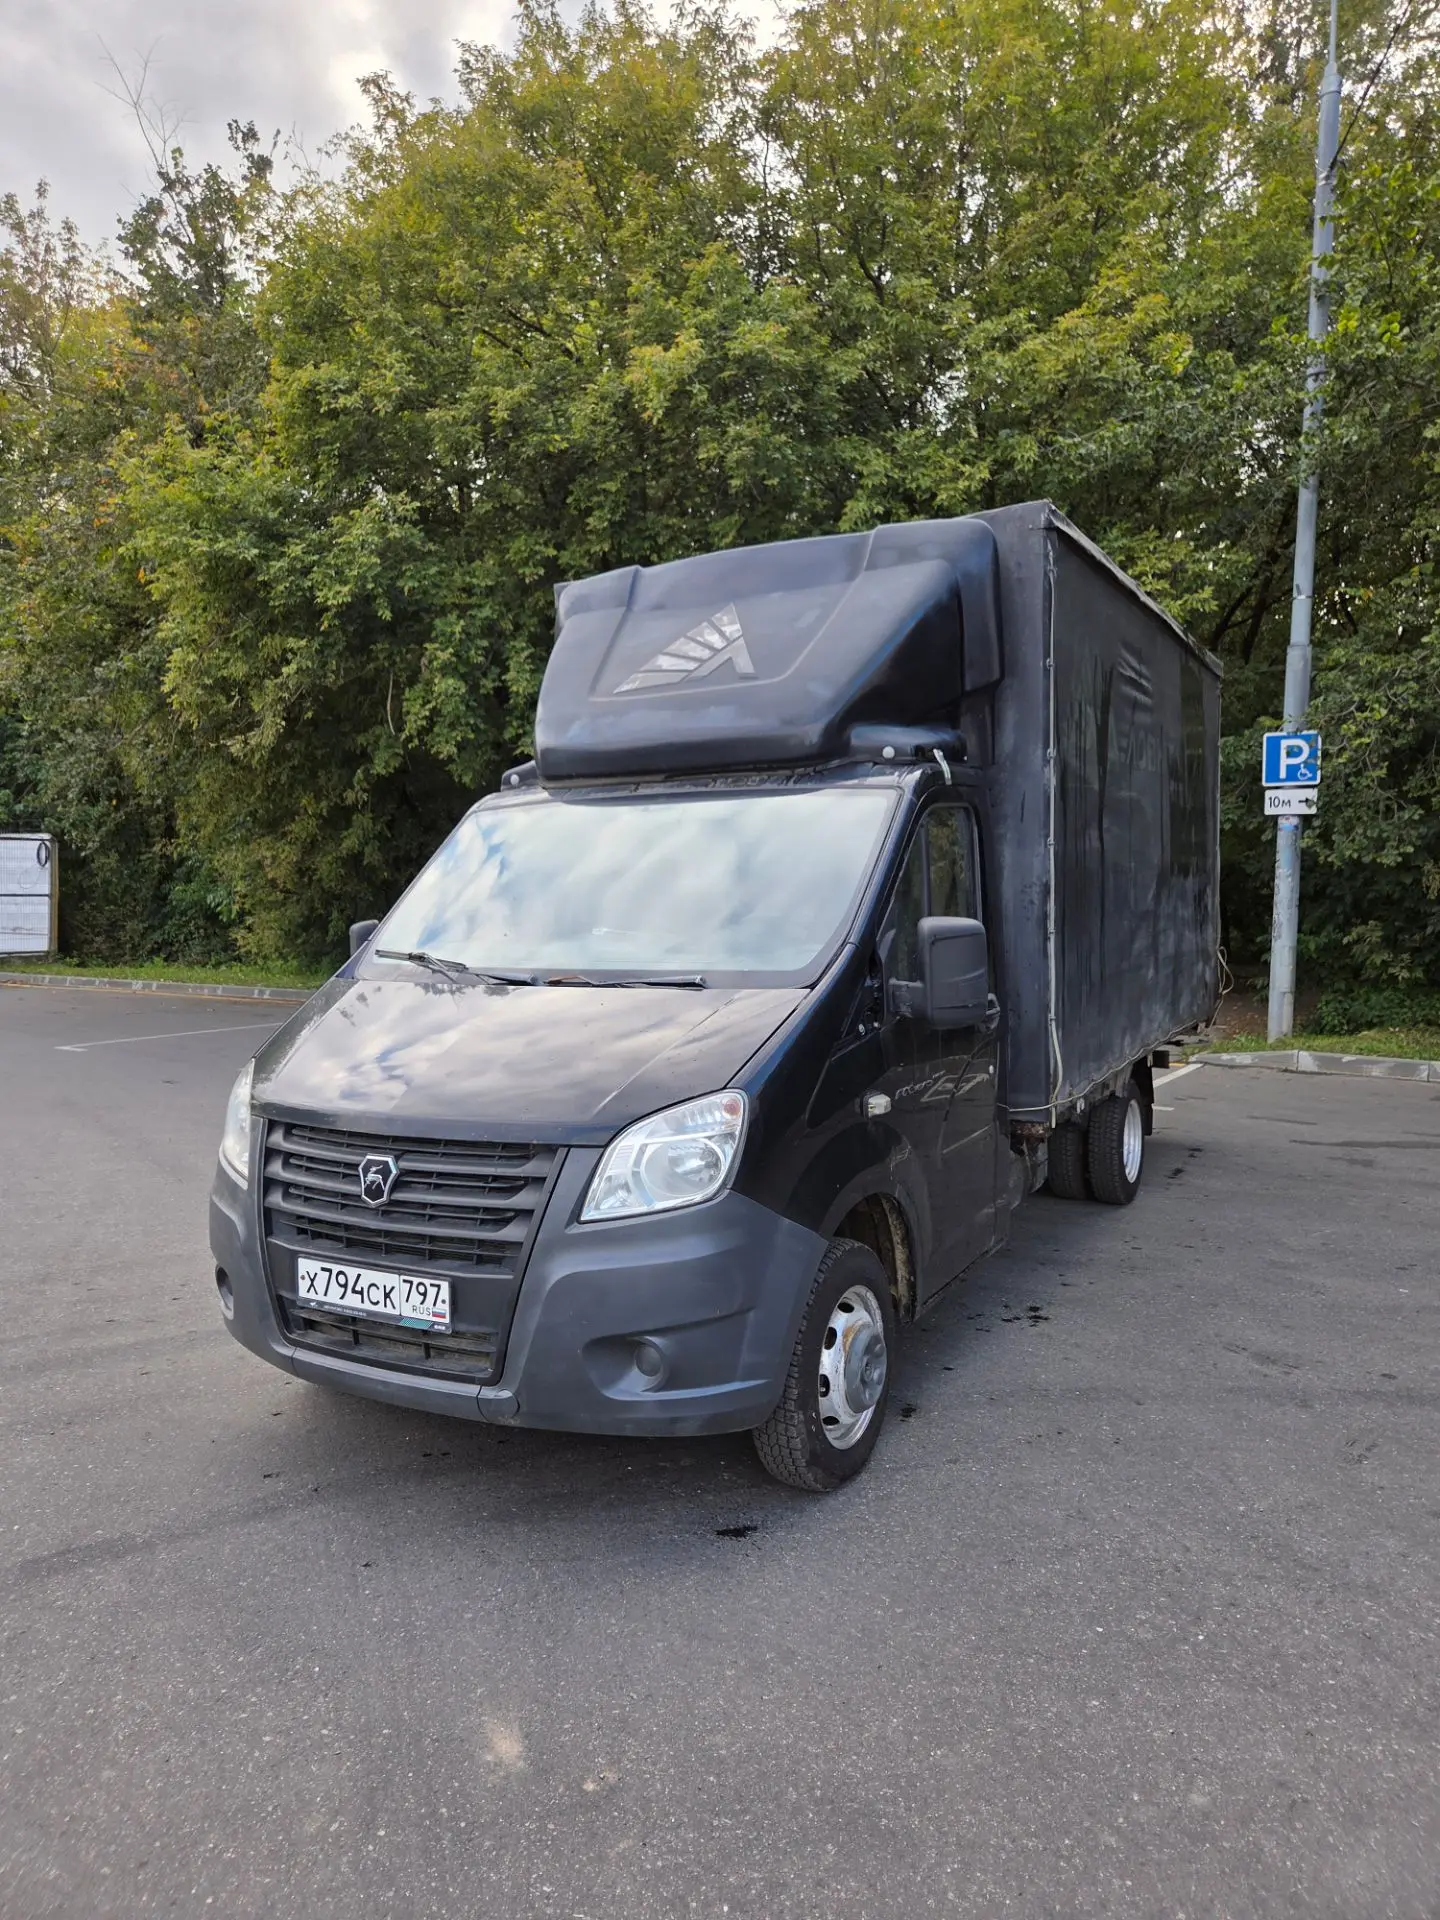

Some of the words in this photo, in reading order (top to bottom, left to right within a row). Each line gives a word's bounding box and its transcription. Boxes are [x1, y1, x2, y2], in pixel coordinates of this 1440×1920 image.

[1279, 738, 1310, 780] P
[402, 1279, 442, 1307] 797
[412, 1305, 431, 1316] RUS
